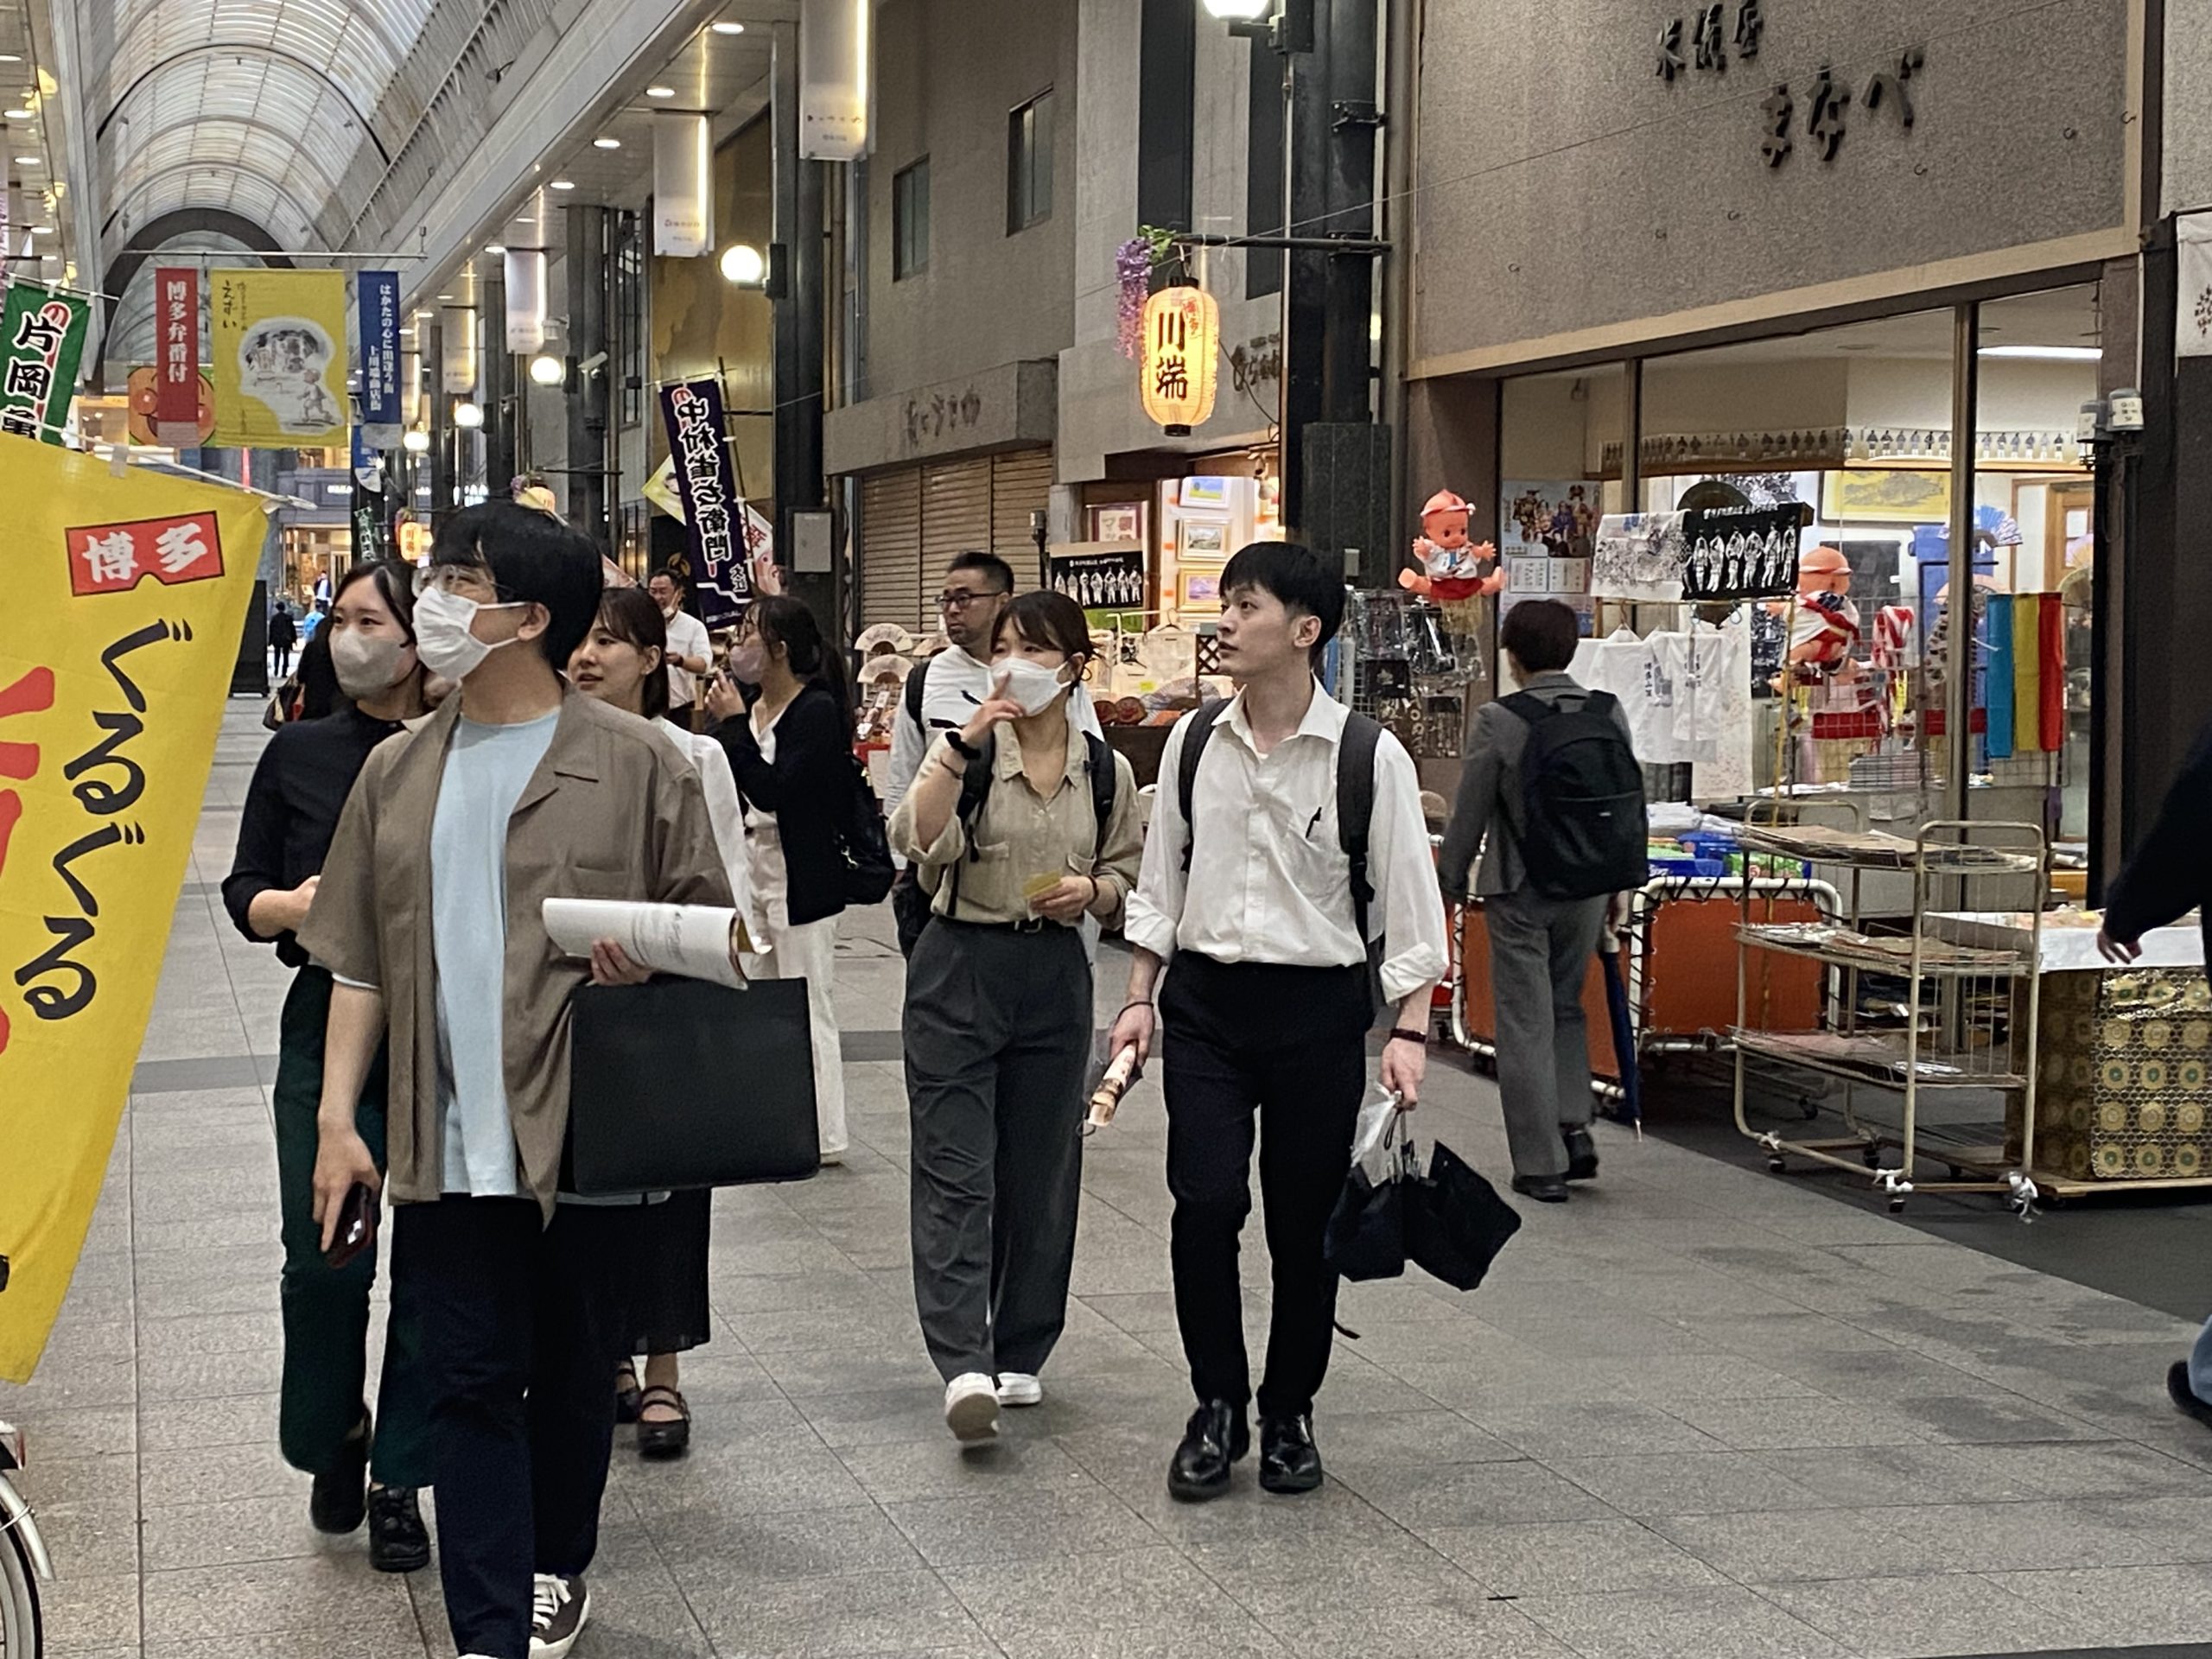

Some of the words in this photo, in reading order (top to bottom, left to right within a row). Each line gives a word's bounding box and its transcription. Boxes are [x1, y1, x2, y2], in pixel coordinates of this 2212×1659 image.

[166, 280, 188, 383] 博多弁番付
[1155, 312, 1188, 402] 川端
[367, 344, 383, 411] 上川端商店街
[81, 522, 209, 585] 博多
[13, 617, 195, 1021] ぐるぐる
